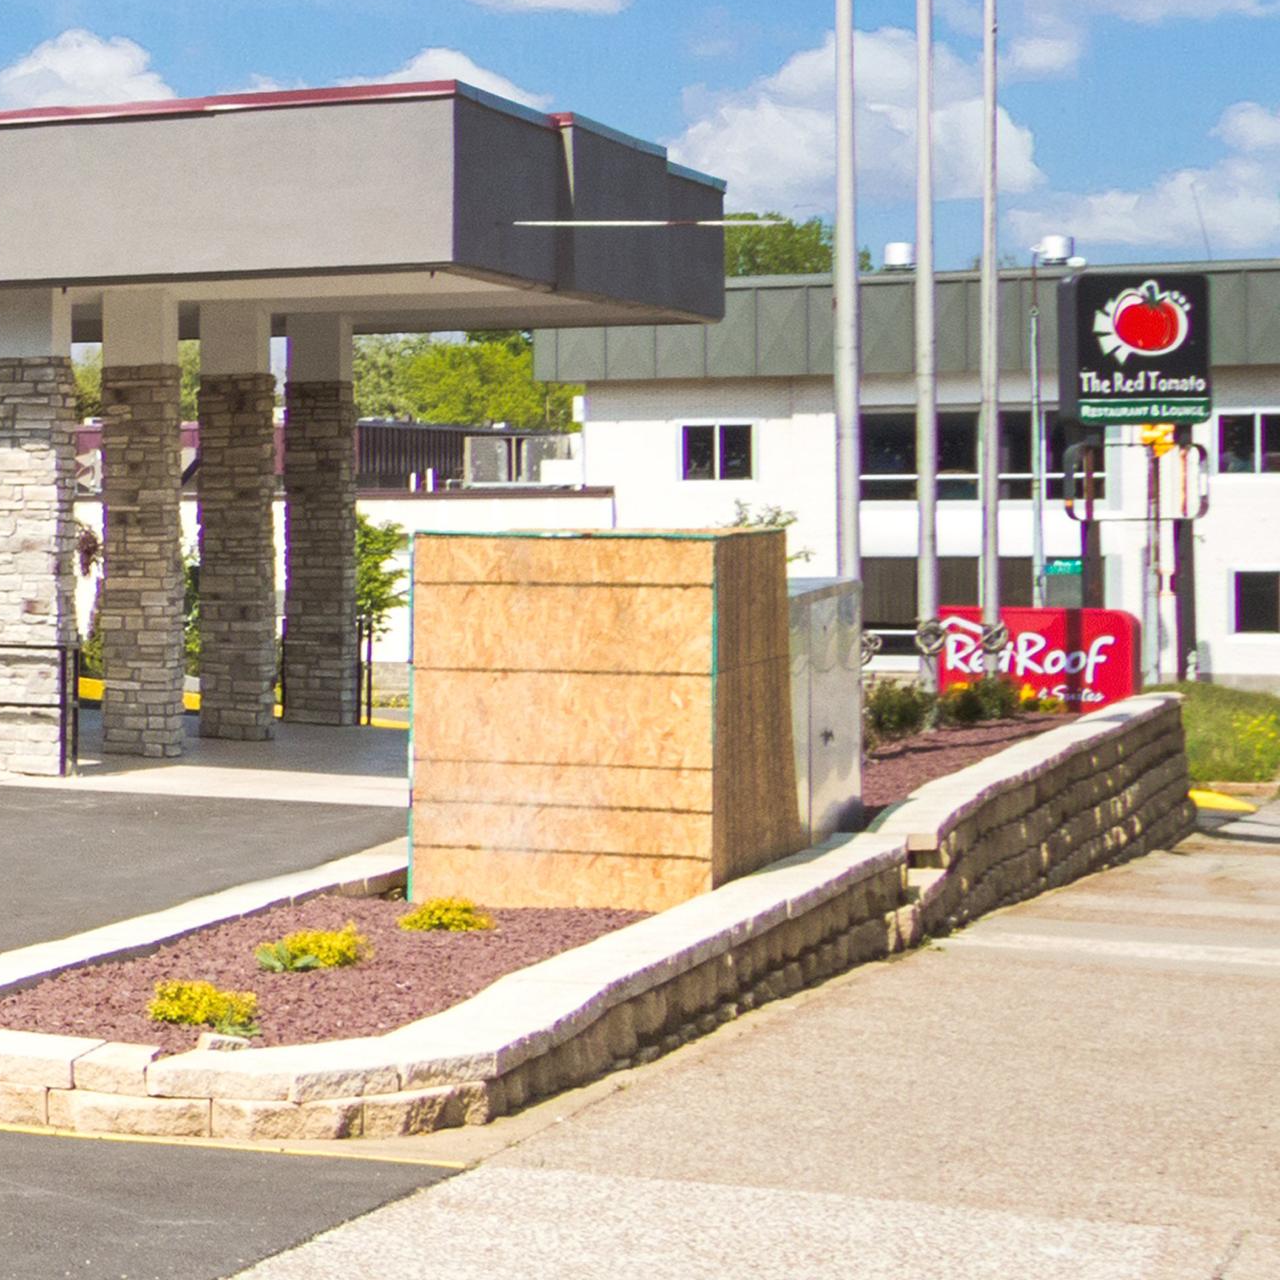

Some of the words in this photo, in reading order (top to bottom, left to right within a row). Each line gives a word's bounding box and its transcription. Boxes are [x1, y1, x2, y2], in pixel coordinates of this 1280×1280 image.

[1079, 371, 1112, 393] The
[1113, 371, 1145, 392] Red
[1147, 371, 1206, 391] Tomato
[1150, 404, 1160, 416] &
[1016, 631, 1116, 684] Roof
